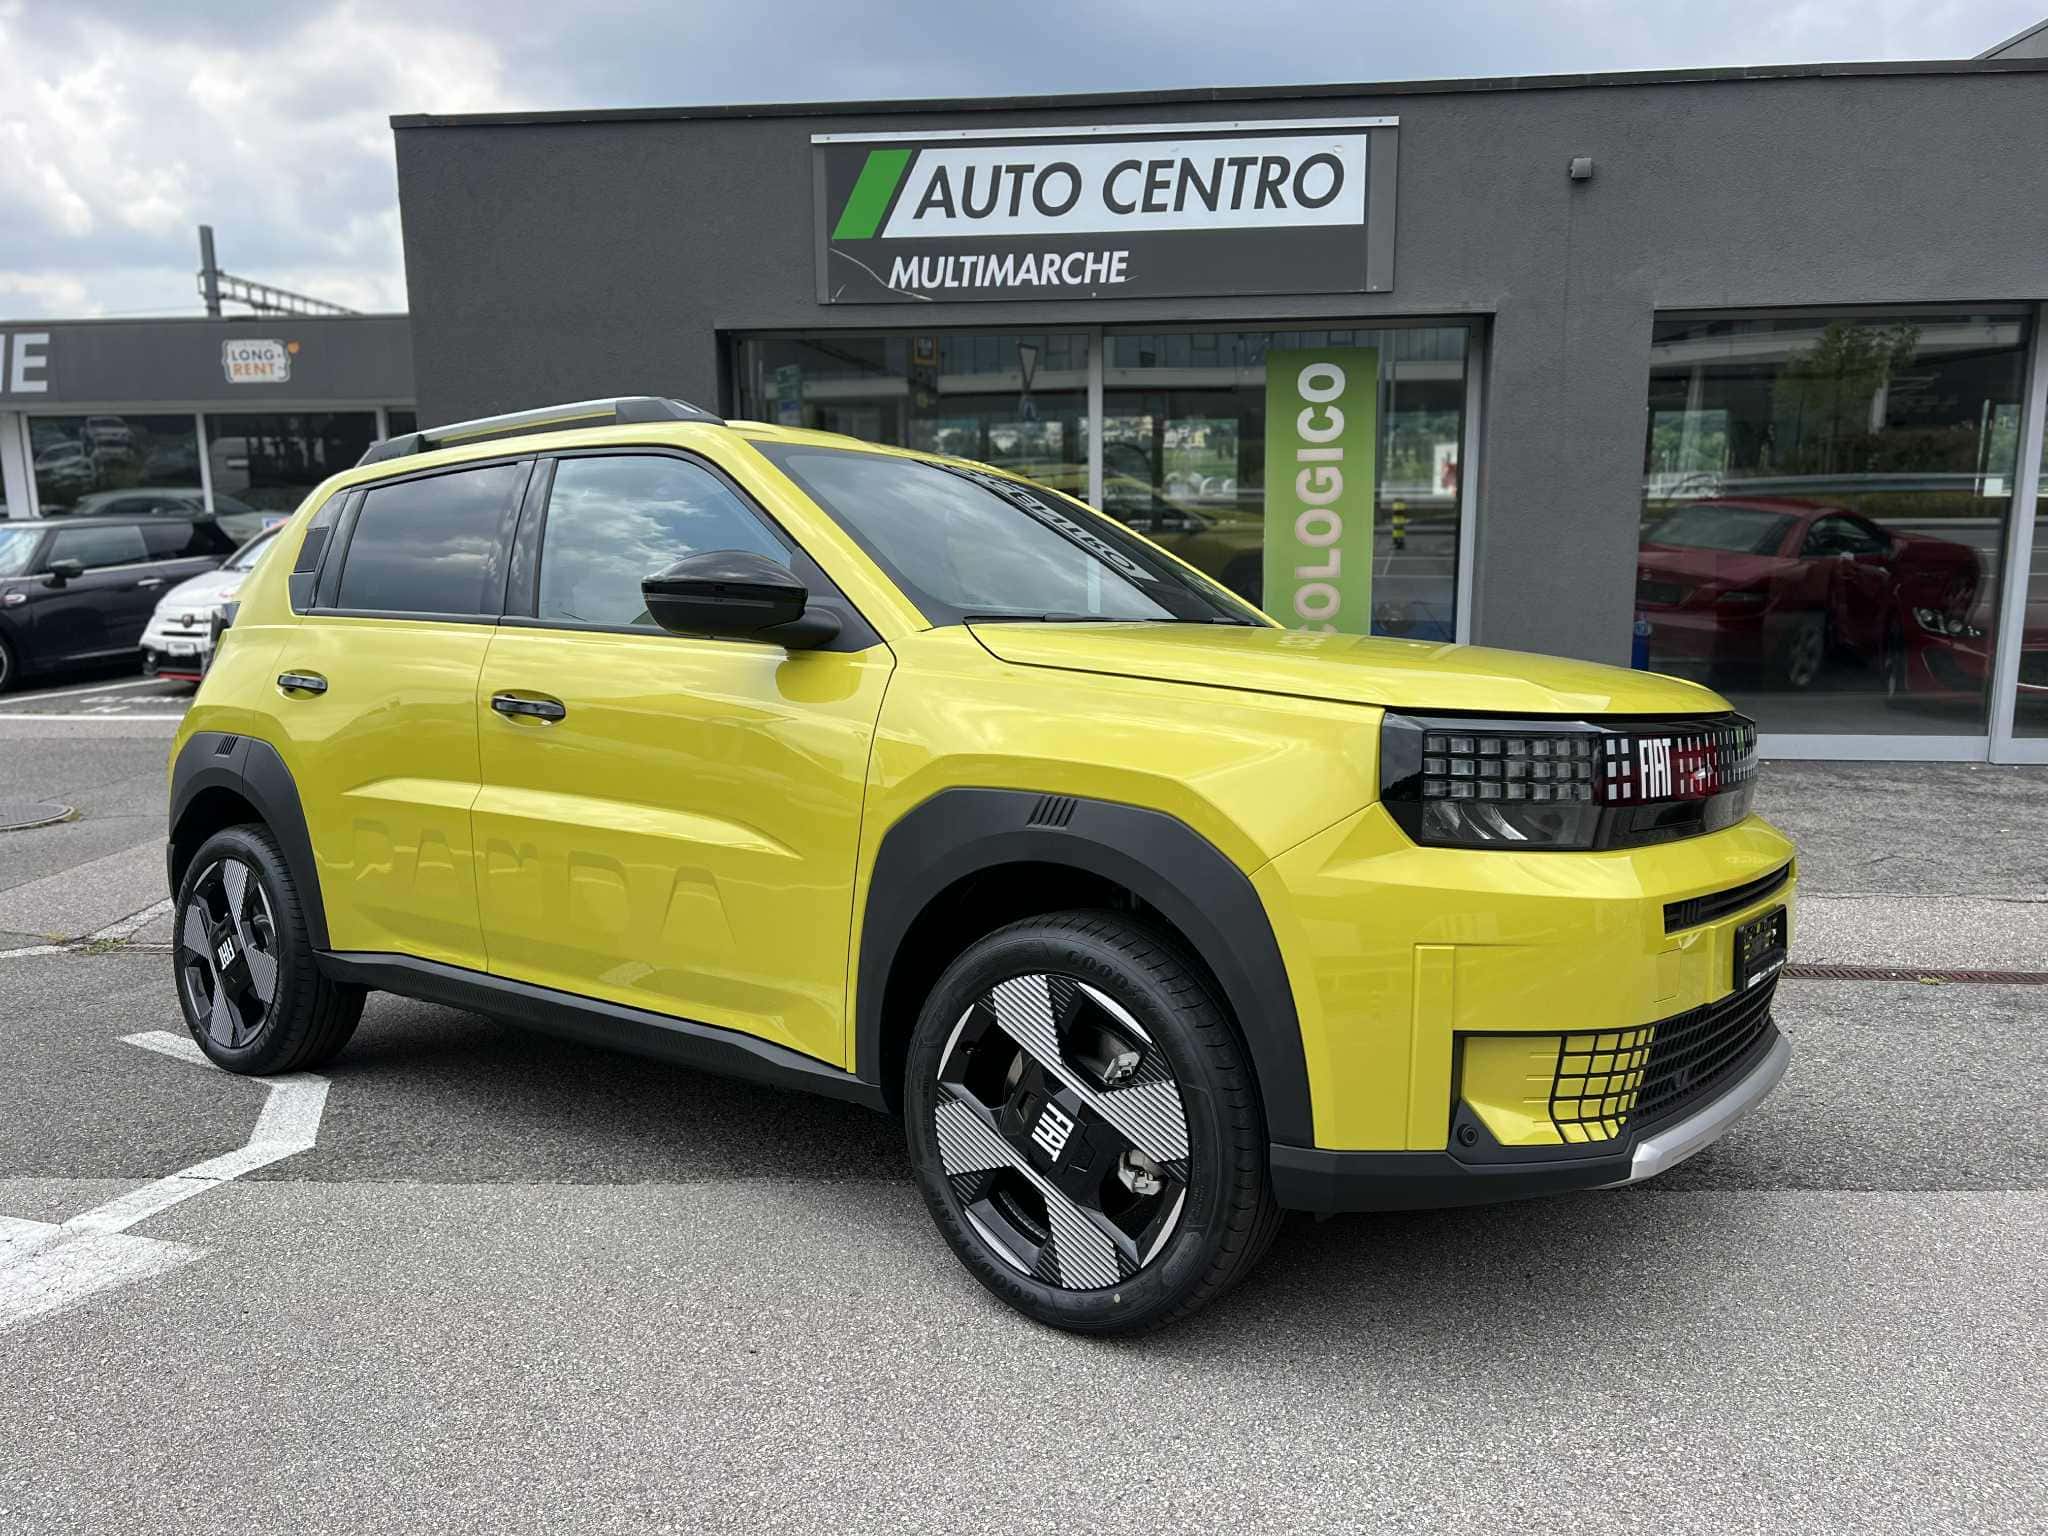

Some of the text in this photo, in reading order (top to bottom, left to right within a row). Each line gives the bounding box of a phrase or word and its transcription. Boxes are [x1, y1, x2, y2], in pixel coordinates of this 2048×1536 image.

[913, 153, 1345, 220] AUTO CENTRO
[888, 251, 1129, 289] MULTIMARCHE
[231, 349, 274, 361] LONG
[233, 363, 274, 376] RENT
[1293, 362, 1346, 634] OLOGICO
[1639, 738, 1672, 799] FIAT
[217, 937, 235, 970] FIAT
[1031, 1102, 1075, 1162] FIAT
